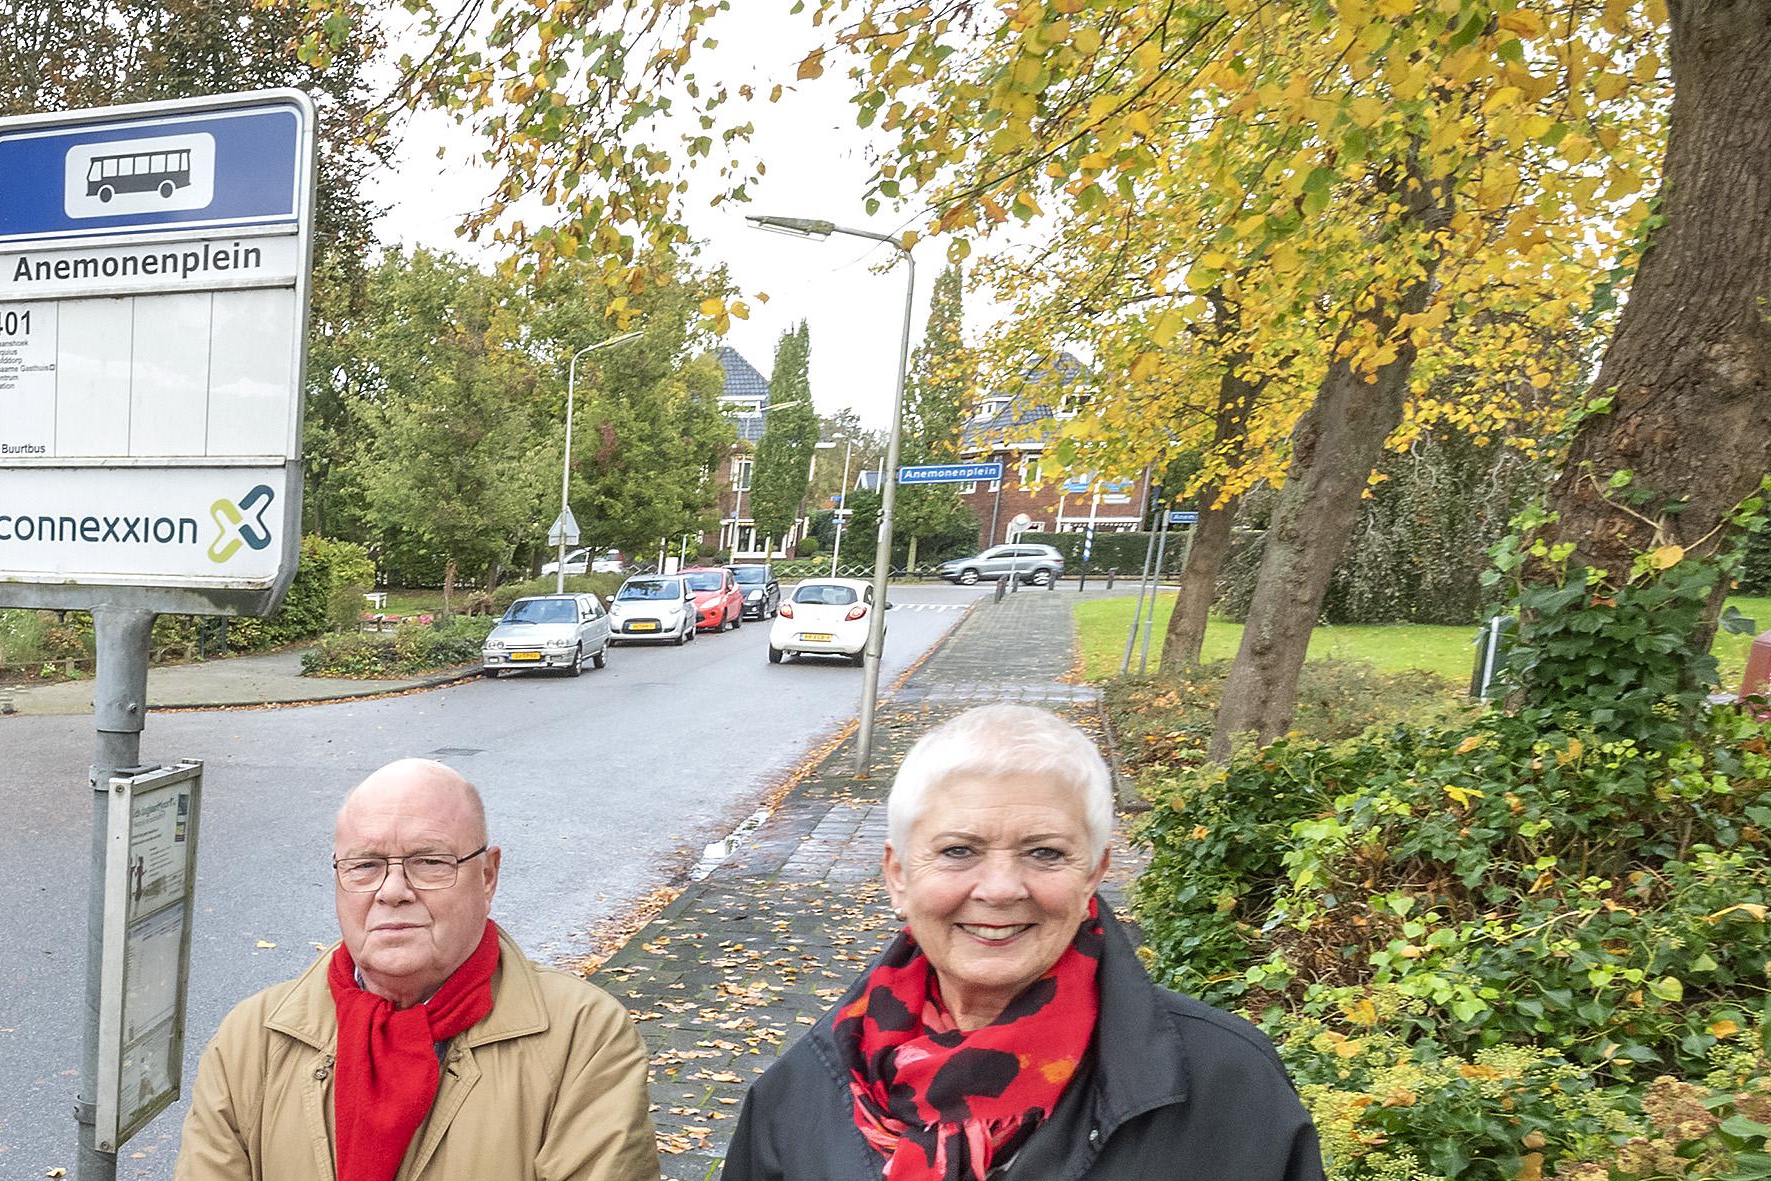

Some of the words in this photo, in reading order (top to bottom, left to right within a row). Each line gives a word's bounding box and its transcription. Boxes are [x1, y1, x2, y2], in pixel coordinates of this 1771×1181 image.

[13, 242, 262, 283] Anemonenplein
[1, 443, 46, 454] Buurtbus
[904, 467, 997, 479] Anemonenplein
